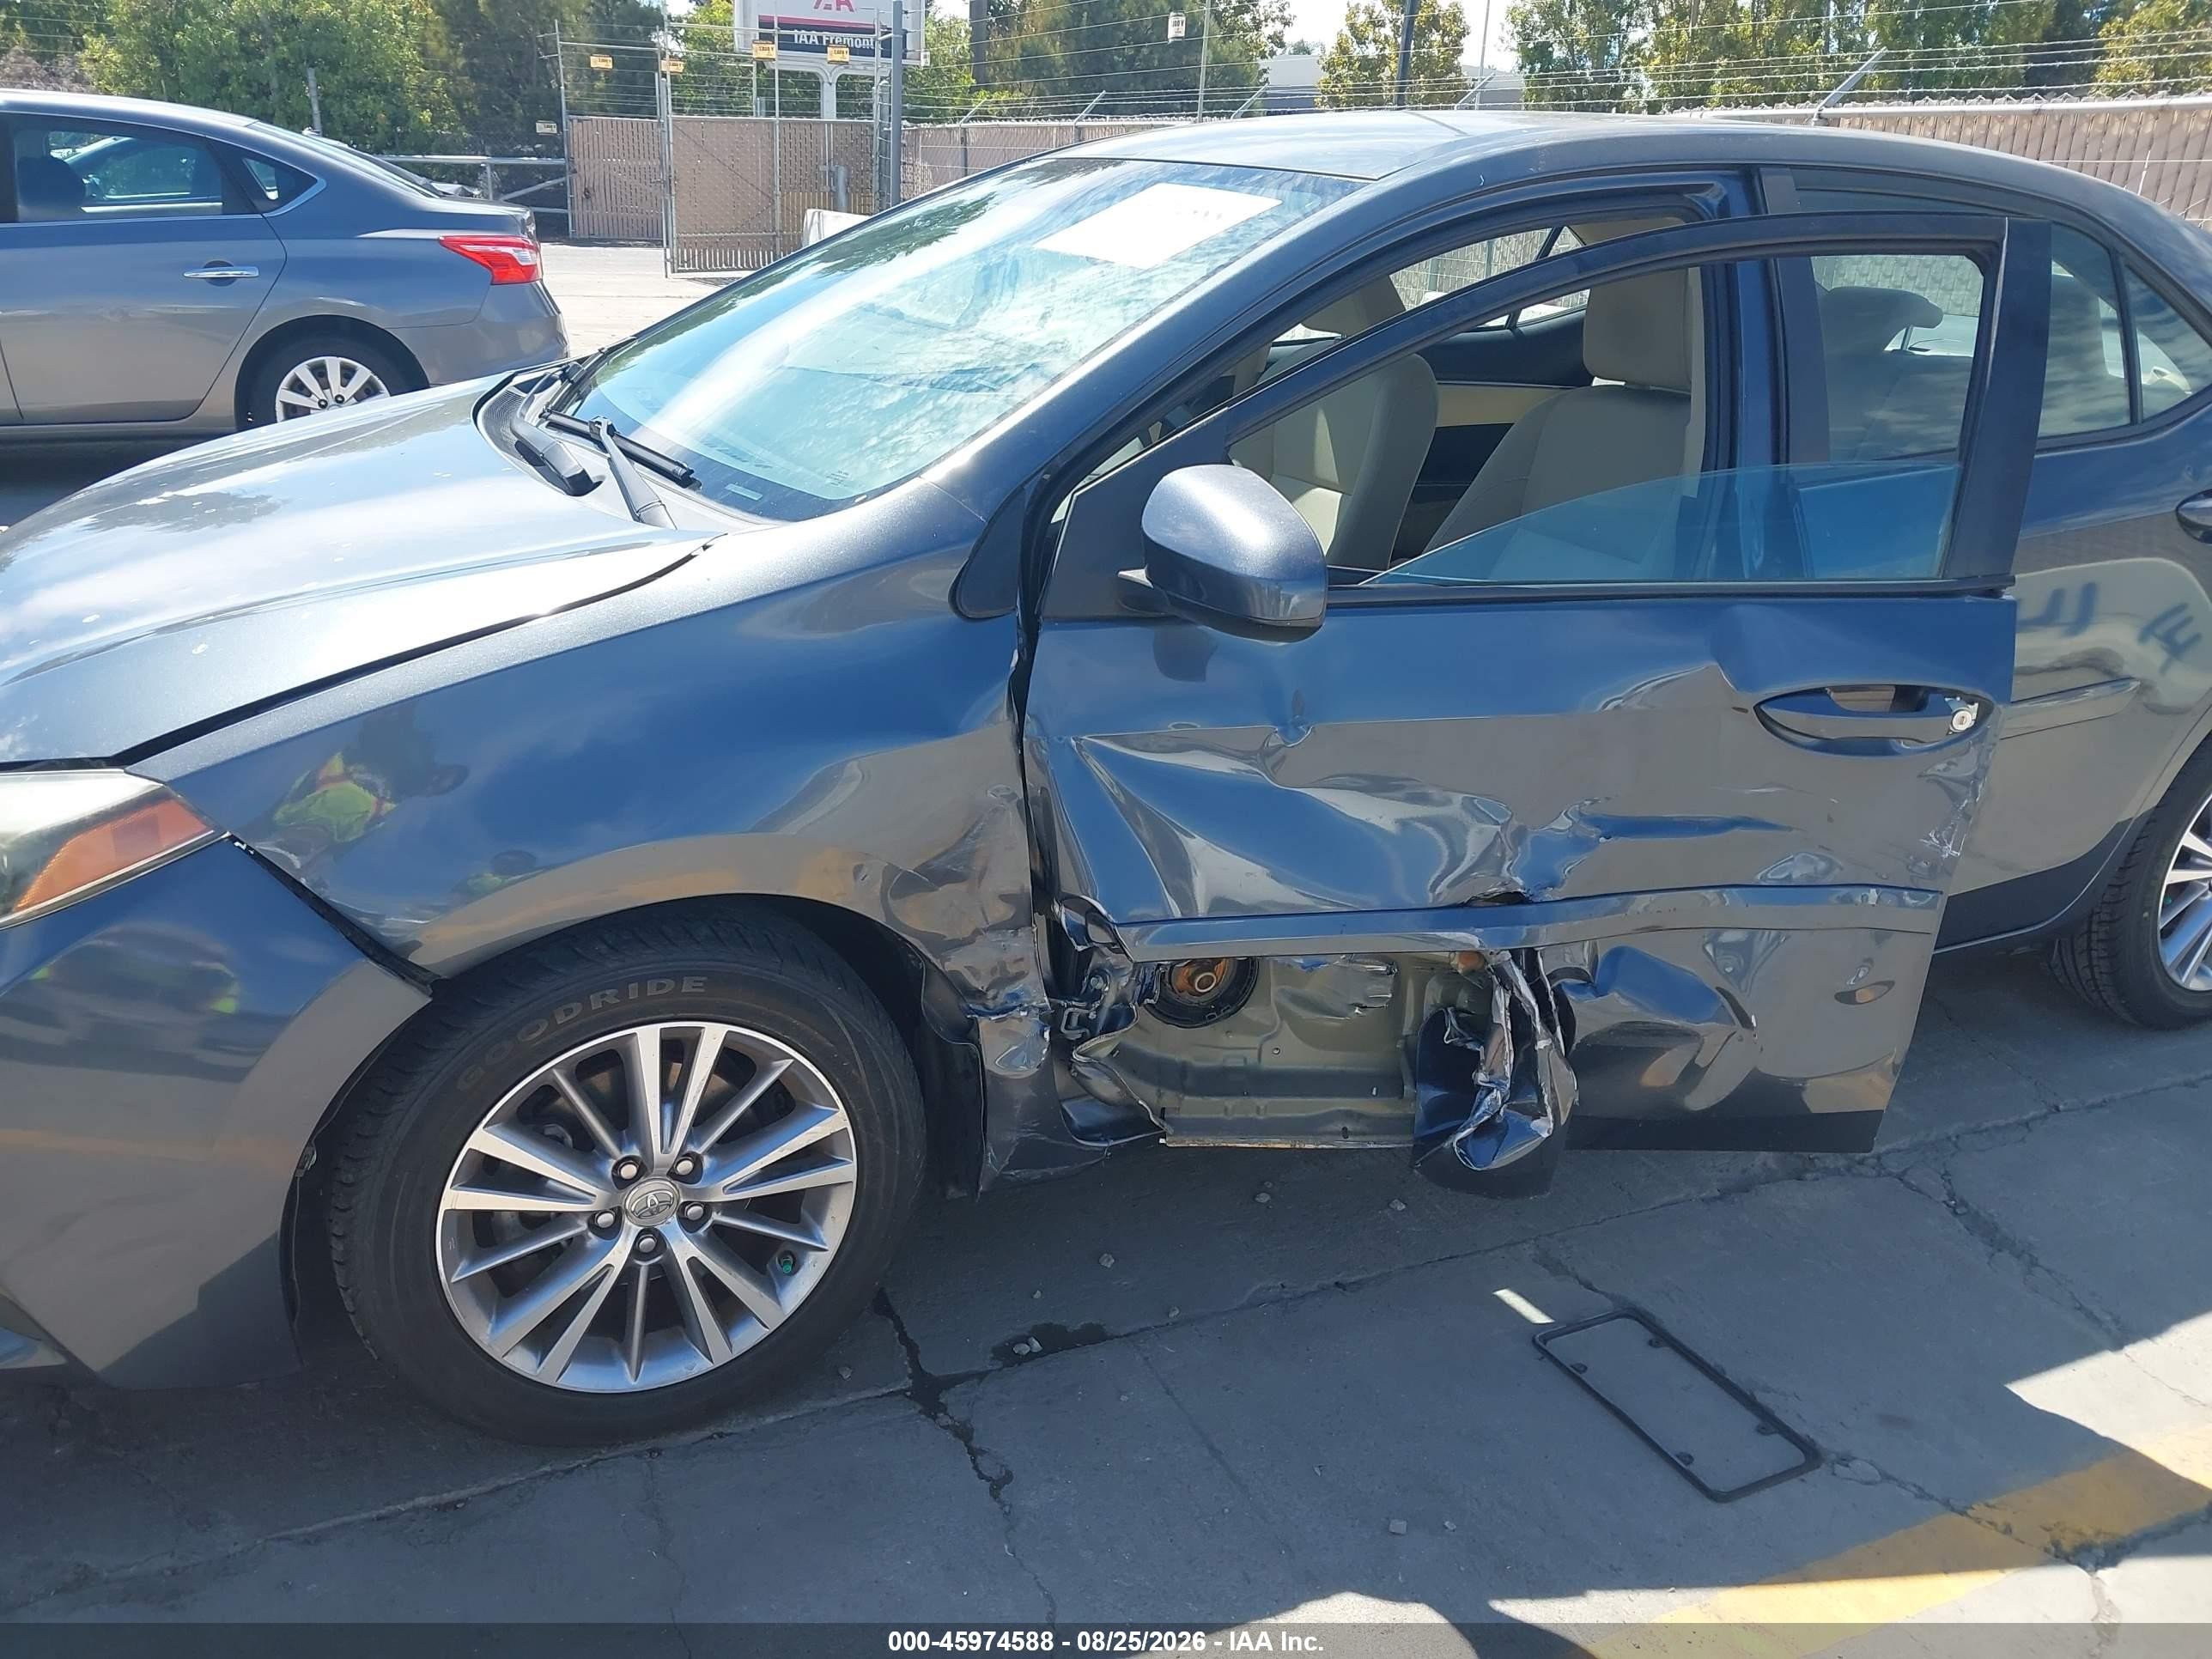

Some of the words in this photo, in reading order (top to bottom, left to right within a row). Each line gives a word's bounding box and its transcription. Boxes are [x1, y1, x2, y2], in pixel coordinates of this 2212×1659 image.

[794, 29, 818, 45] IAA
[823, 32, 874, 49] Fremont
[457, 975, 708, 1088] GOODRIDE
